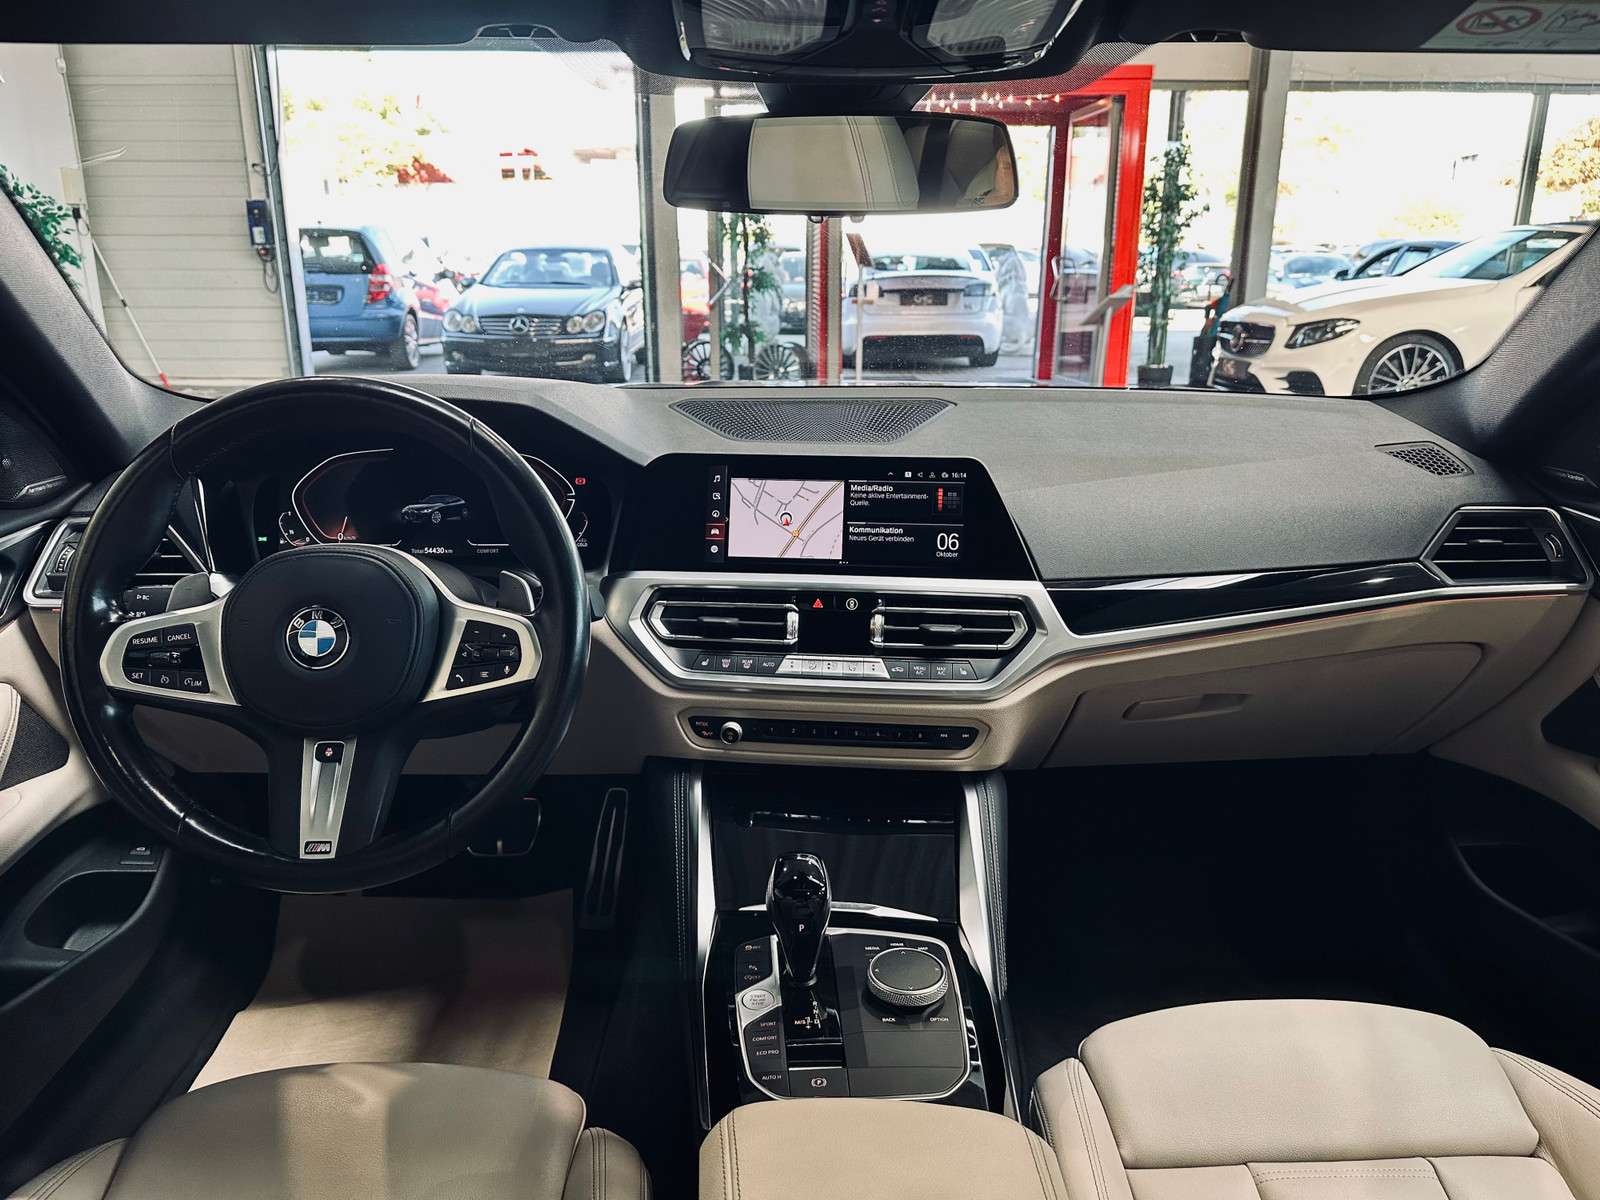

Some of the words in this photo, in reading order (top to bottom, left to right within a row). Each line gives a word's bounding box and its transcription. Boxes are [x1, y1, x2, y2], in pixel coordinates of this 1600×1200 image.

[850, 484, 894, 492] Media/Radio
[849, 526, 904, 534] Kommunikation
[885, 535, 915, 543] verbinden
[937, 533, 960, 551] 06
[293, 610, 344, 629] BMW
[132, 636, 159, 645] RESUME
[167, 633, 192, 642] CANCEL
[799, 924, 805, 932] P
